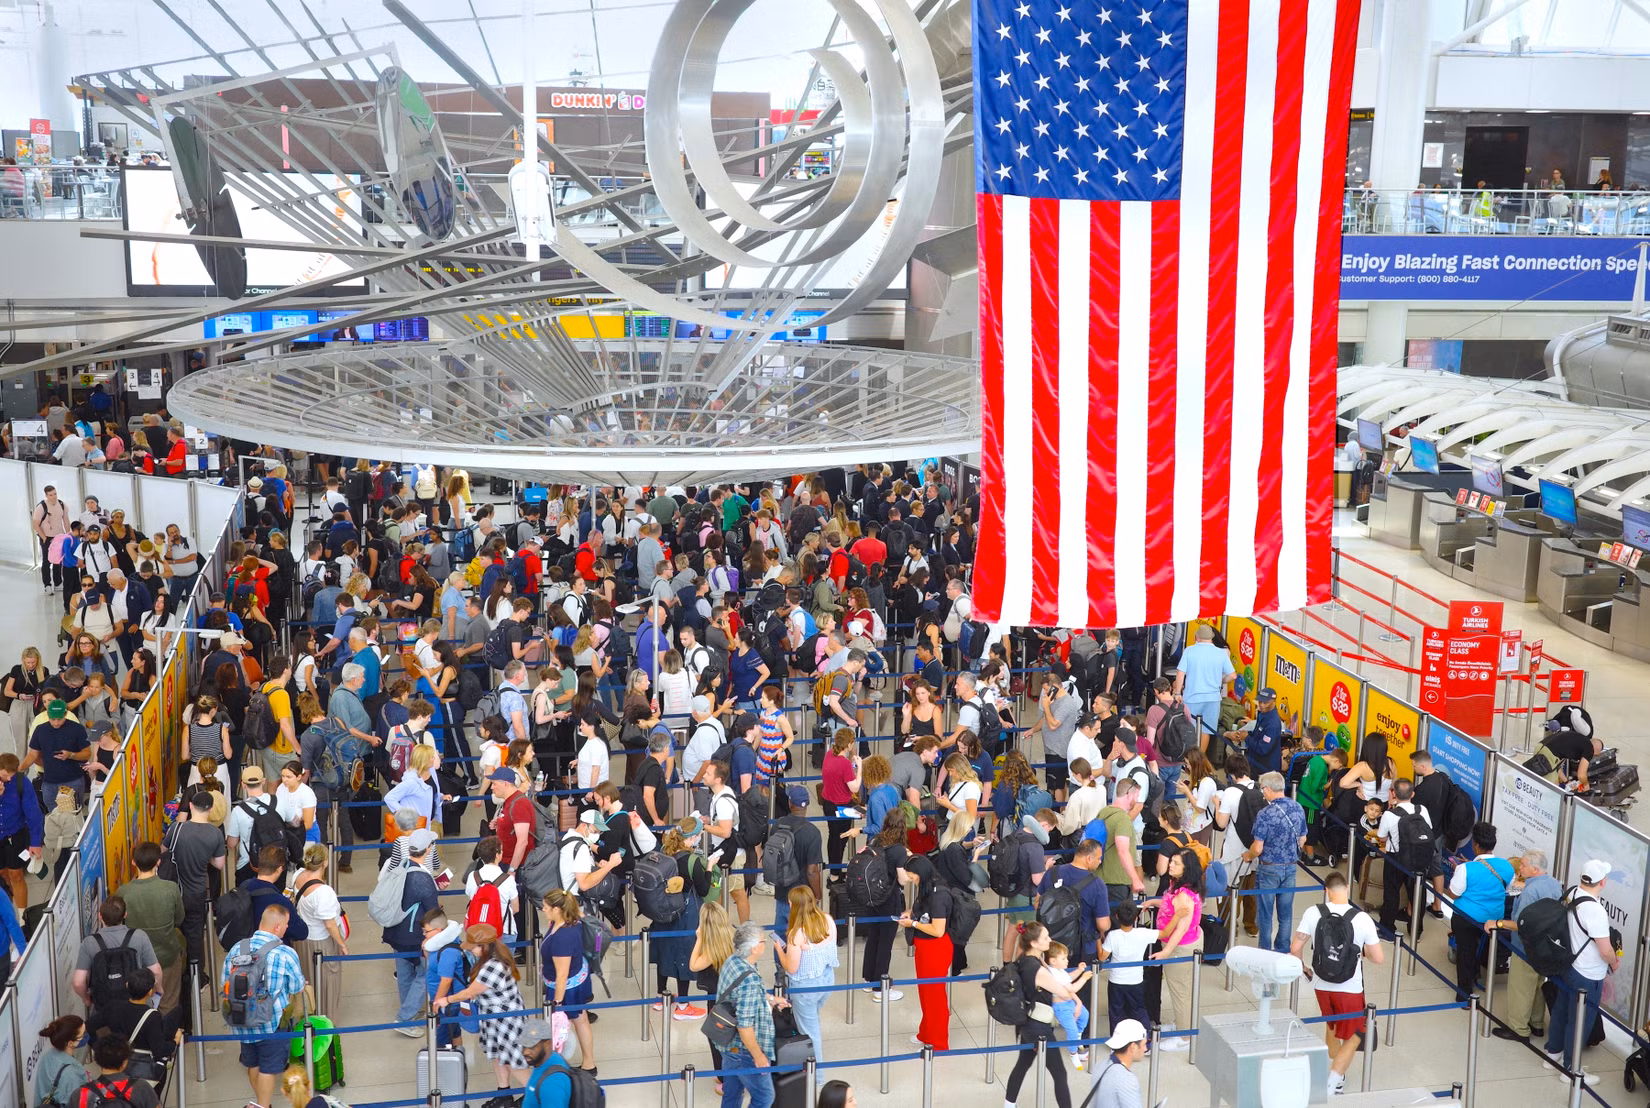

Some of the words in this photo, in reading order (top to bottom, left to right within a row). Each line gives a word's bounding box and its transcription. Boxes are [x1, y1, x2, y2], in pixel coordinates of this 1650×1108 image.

[551, 92, 617, 108] DUNKIN'
[1342, 253, 1390, 272] Enjoy
[1394, 253, 1458, 273] Blazing
[1462, 255, 1500, 270] Fast
[1504, 255, 1601, 270] Connection
[1605, 256, 1650, 274] Spe
[1379, 275, 1415, 284] Support:
[1417, 275, 1440, 284] (800)
[36, 424, 44, 434] 4
[945, 464, 955, 476] BOSS
[969, 474, 981, 484] BO
[1241, 641, 1252, 658] $32
[1332, 696, 1349, 716] $32
[1376, 712, 1401, 734] enjoy
[1432, 746, 1445, 757] START
[1445, 753, 1467, 770] SHOPPING
[1523, 782, 1543, 800] BEAUTY
[1502, 786, 1511, 795] TAX
[1512, 791, 1524, 804] FREE
[1528, 801, 1541, 813] DUTY
[1542, 809, 1554, 821] FREE
[1600, 897, 1628, 926] EAUTY
